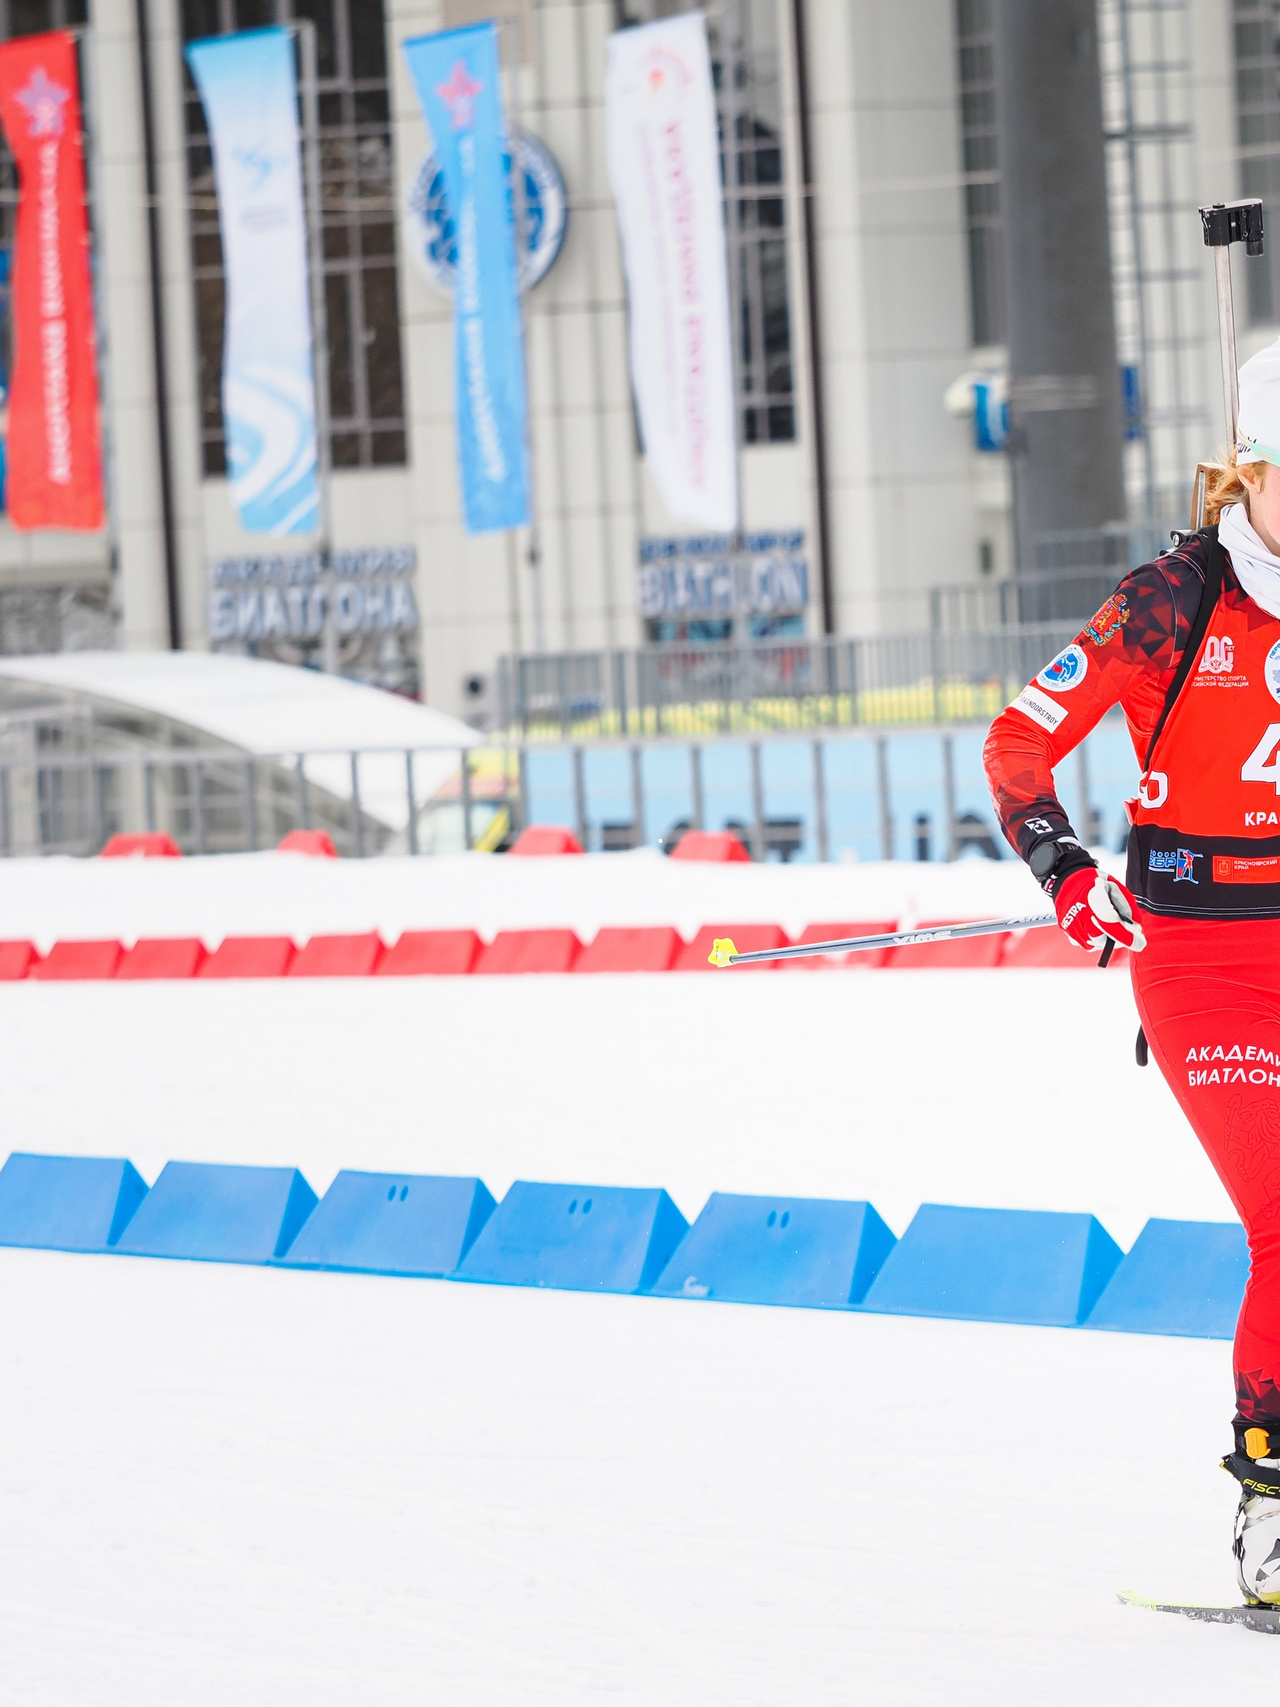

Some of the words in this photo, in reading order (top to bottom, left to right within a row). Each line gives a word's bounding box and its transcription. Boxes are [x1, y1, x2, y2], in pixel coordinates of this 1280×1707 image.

[639, 553, 809, 618] BIATHON
[1060, 902, 1086, 930] HESTRA
[893, 930, 952, 944] SWIX
